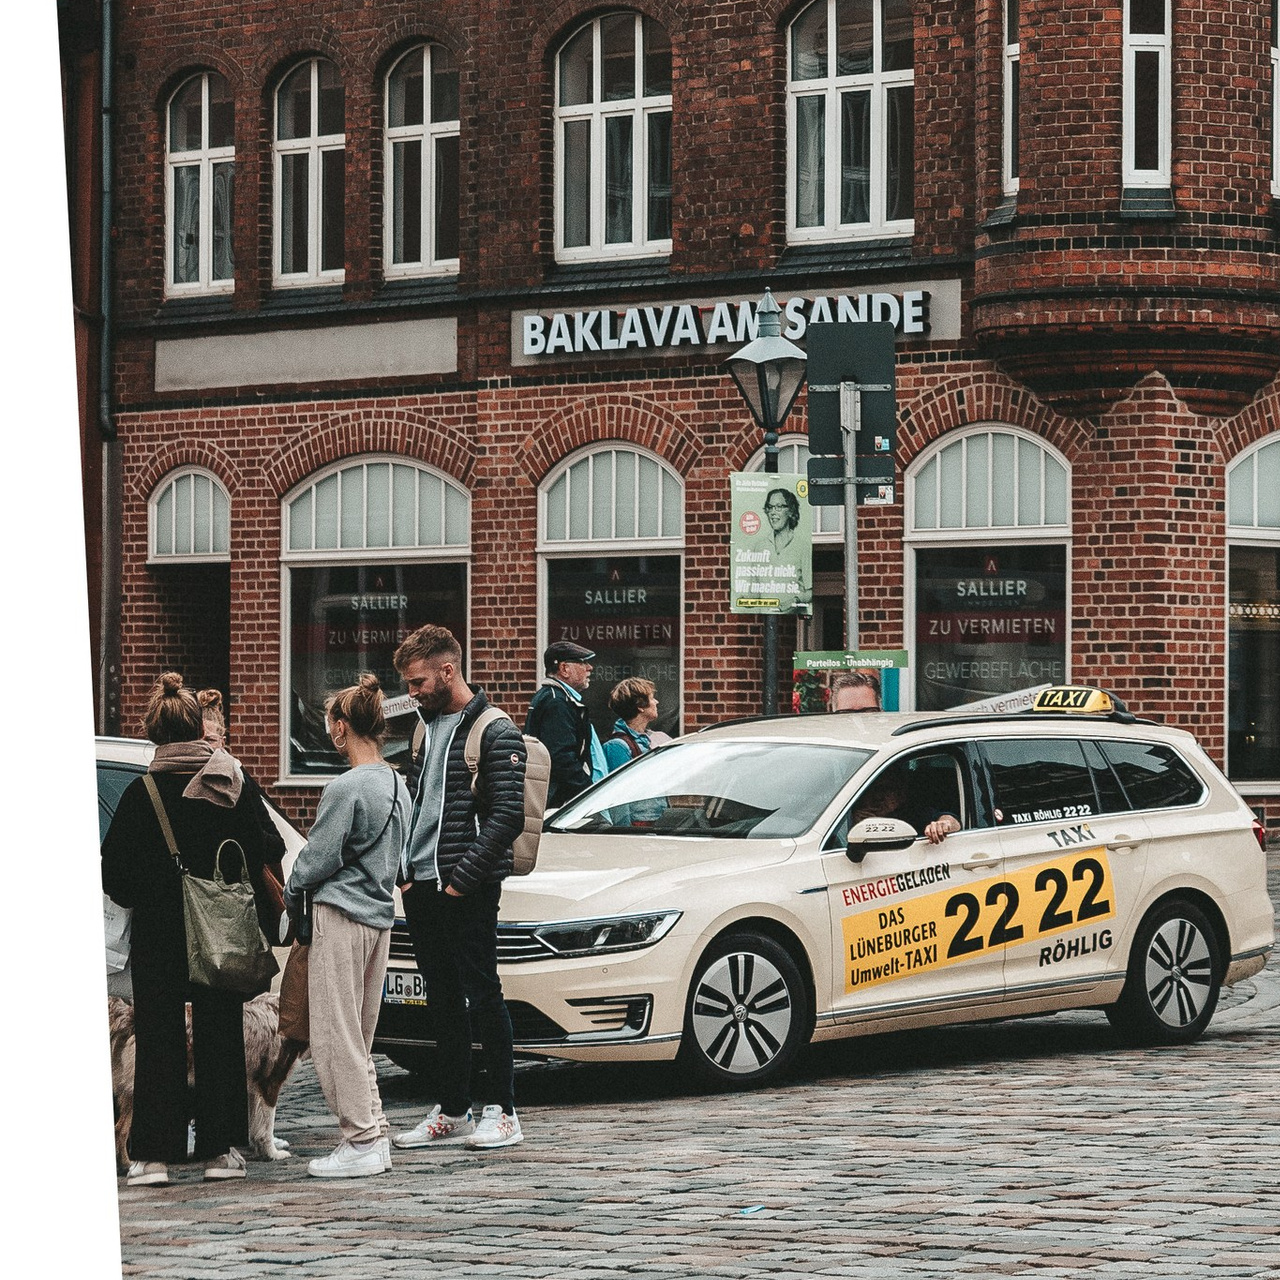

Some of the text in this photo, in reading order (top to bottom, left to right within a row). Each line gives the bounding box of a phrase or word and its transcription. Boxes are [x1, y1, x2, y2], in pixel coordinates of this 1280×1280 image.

[523, 291, 923, 355] BAKLAVA AM SANDE
[735, 549, 770, 563] Zukunft
[735, 564, 797, 579] passiert nicht.
[735, 580, 801, 594] Wir machen sie.
[957, 580, 1027, 596] SALLIER
[351, 595, 408, 610] SALLIER
[585, 589, 647, 604] SALLIER
[561, 624, 672, 640] ZU VERMIETEN
[929, 618, 1055, 635] ZU VERMIETEN
[328, 629, 413, 645] ZU VERMIET
[806, 658, 893, 668] Parteilos Unabhängig
[924, 658, 1062, 679] GEWERBEFLÄCHE
[1042, 690, 1087, 707] TAXI
[1012, 812, 1032, 824] TAXI
[1033, 809, 1063, 821] RÖHLIG
[1047, 823, 1096, 848] TAXI
[842, 862, 951, 907] ENERGIEGELADEN
[944, 857, 1111, 959] 22 22
[878, 907, 905, 930] DAS
[850, 921, 938, 961] LÜNEBURGER
[1039, 929, 1112, 967] RÖHLIG
[850, 944, 938, 986] Umwelt-TAXI
[386, 974, 403, 996] LG
